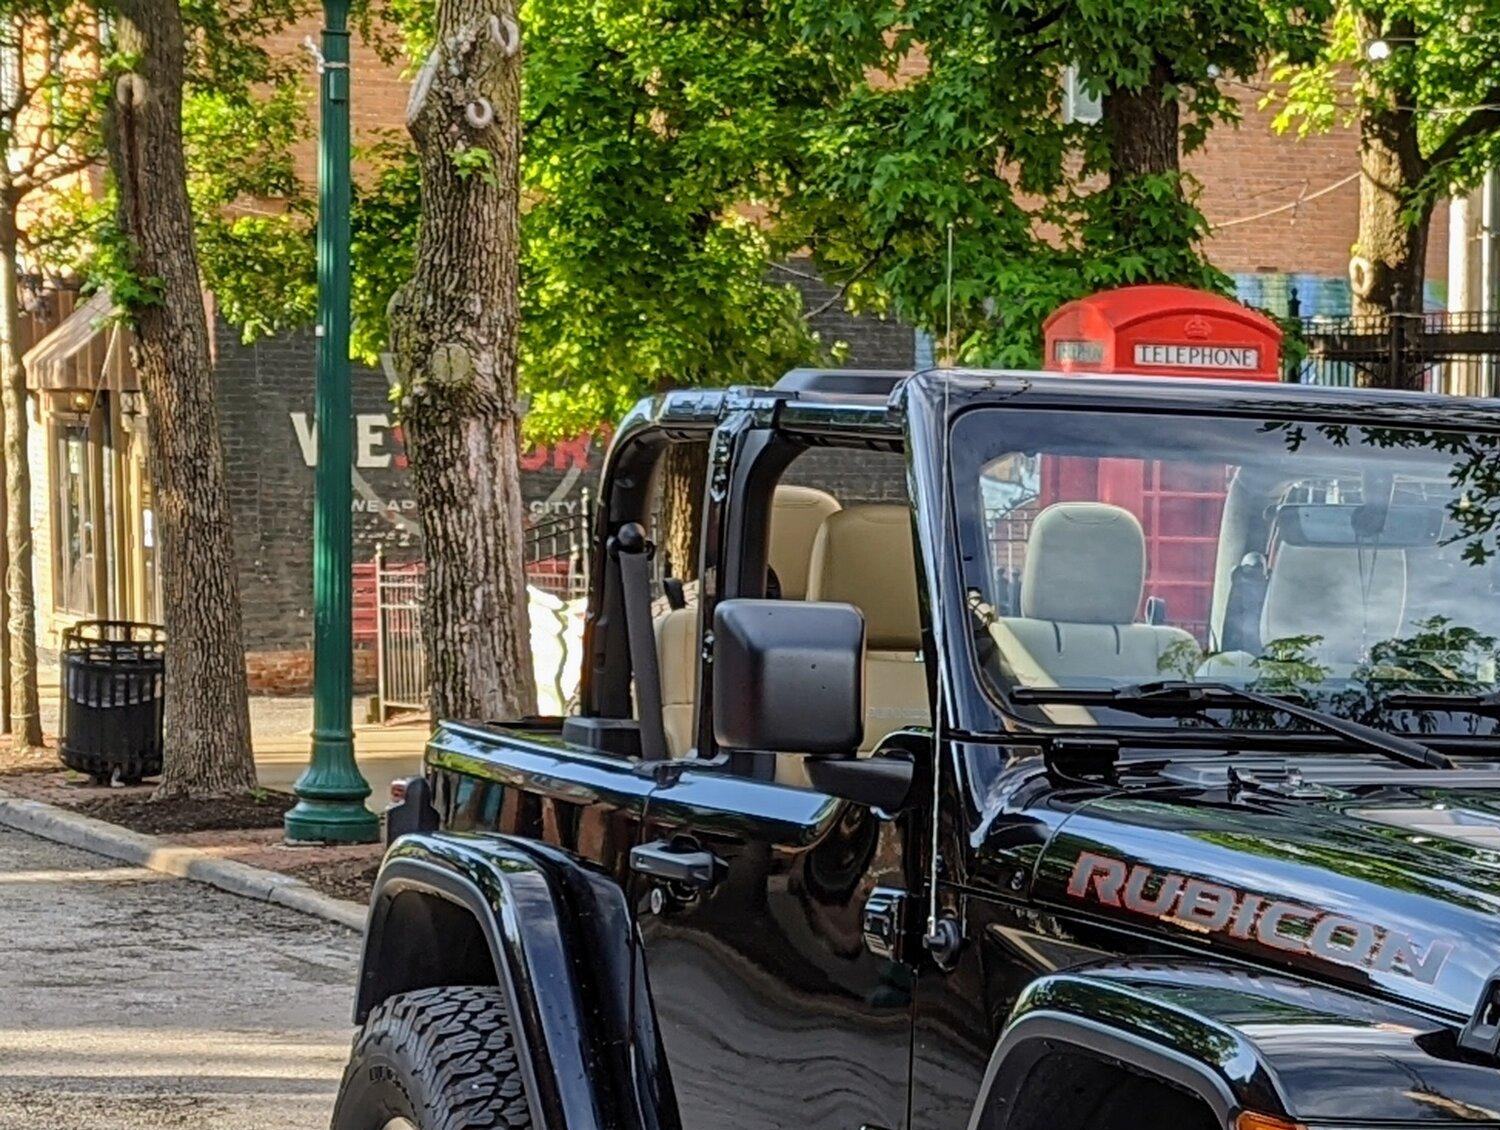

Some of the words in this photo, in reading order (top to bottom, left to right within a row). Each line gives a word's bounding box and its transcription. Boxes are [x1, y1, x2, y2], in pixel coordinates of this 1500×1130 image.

[1141, 345, 1254, 367] TELEPHONE
[529, 500, 577, 516] CITY
[1066, 850, 1457, 985] RUBICON
